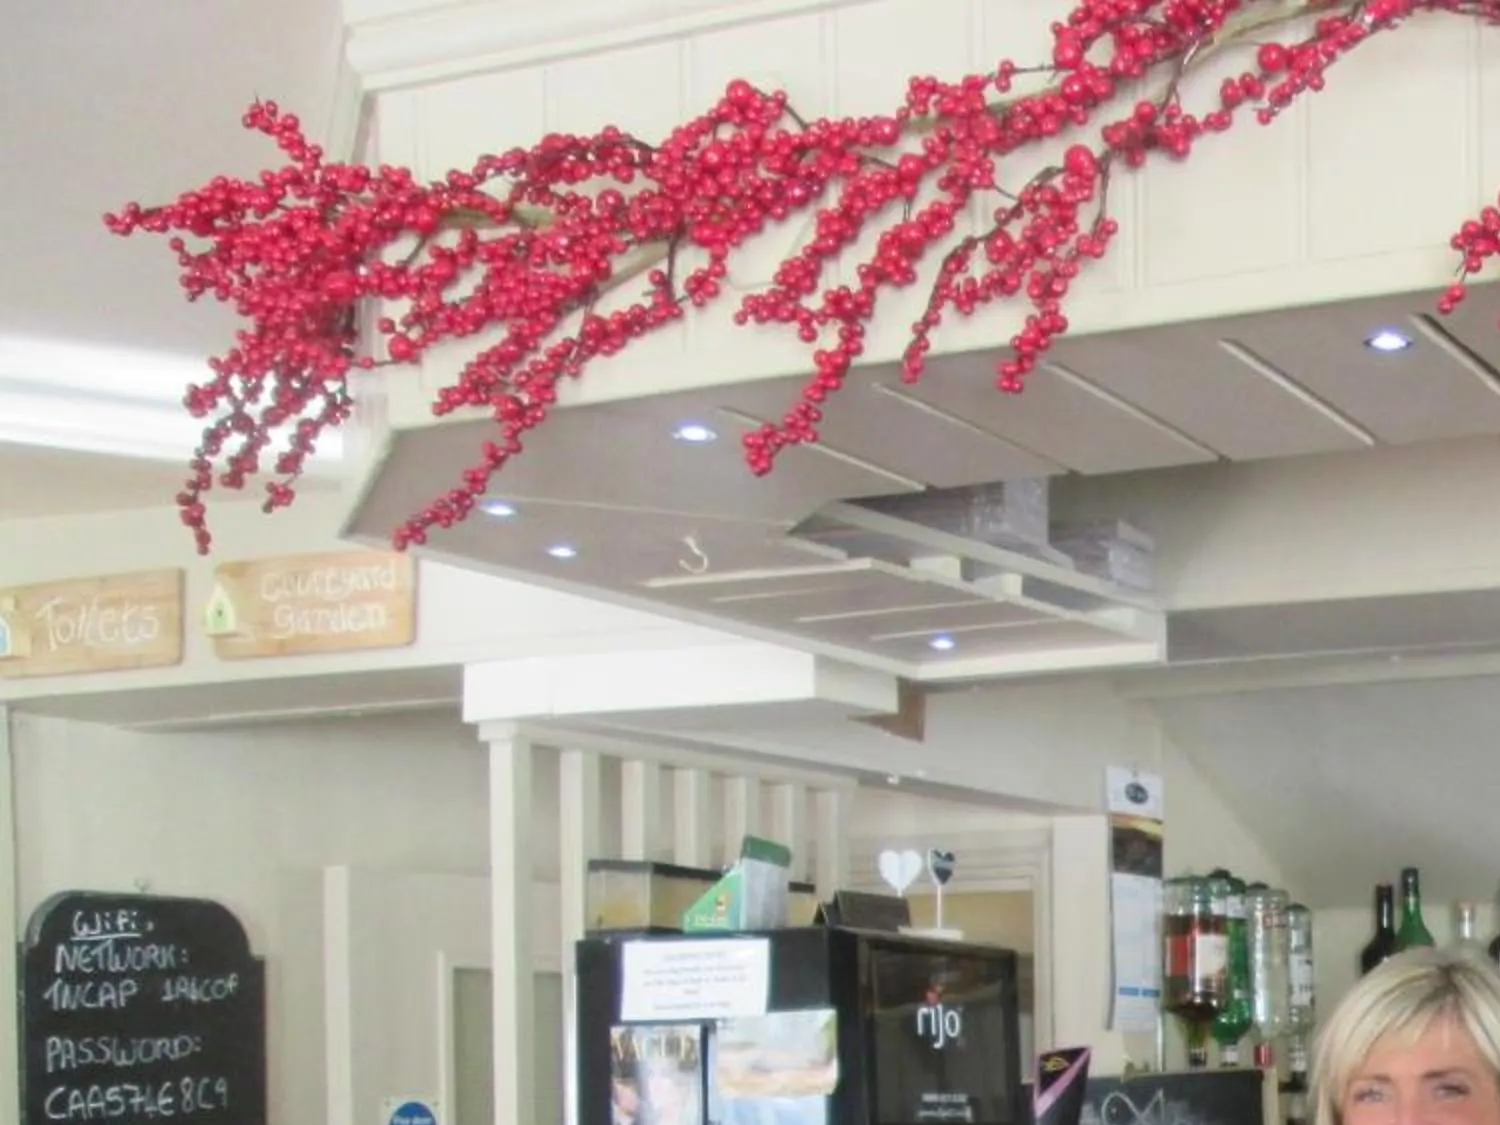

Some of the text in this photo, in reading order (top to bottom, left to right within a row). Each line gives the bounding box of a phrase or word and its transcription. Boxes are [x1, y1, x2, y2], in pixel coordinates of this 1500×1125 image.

[36, 596, 161, 652] Toilets
[272, 603, 388, 640] Garden
[46, 1034, 202, 1073] PASSWORD:
